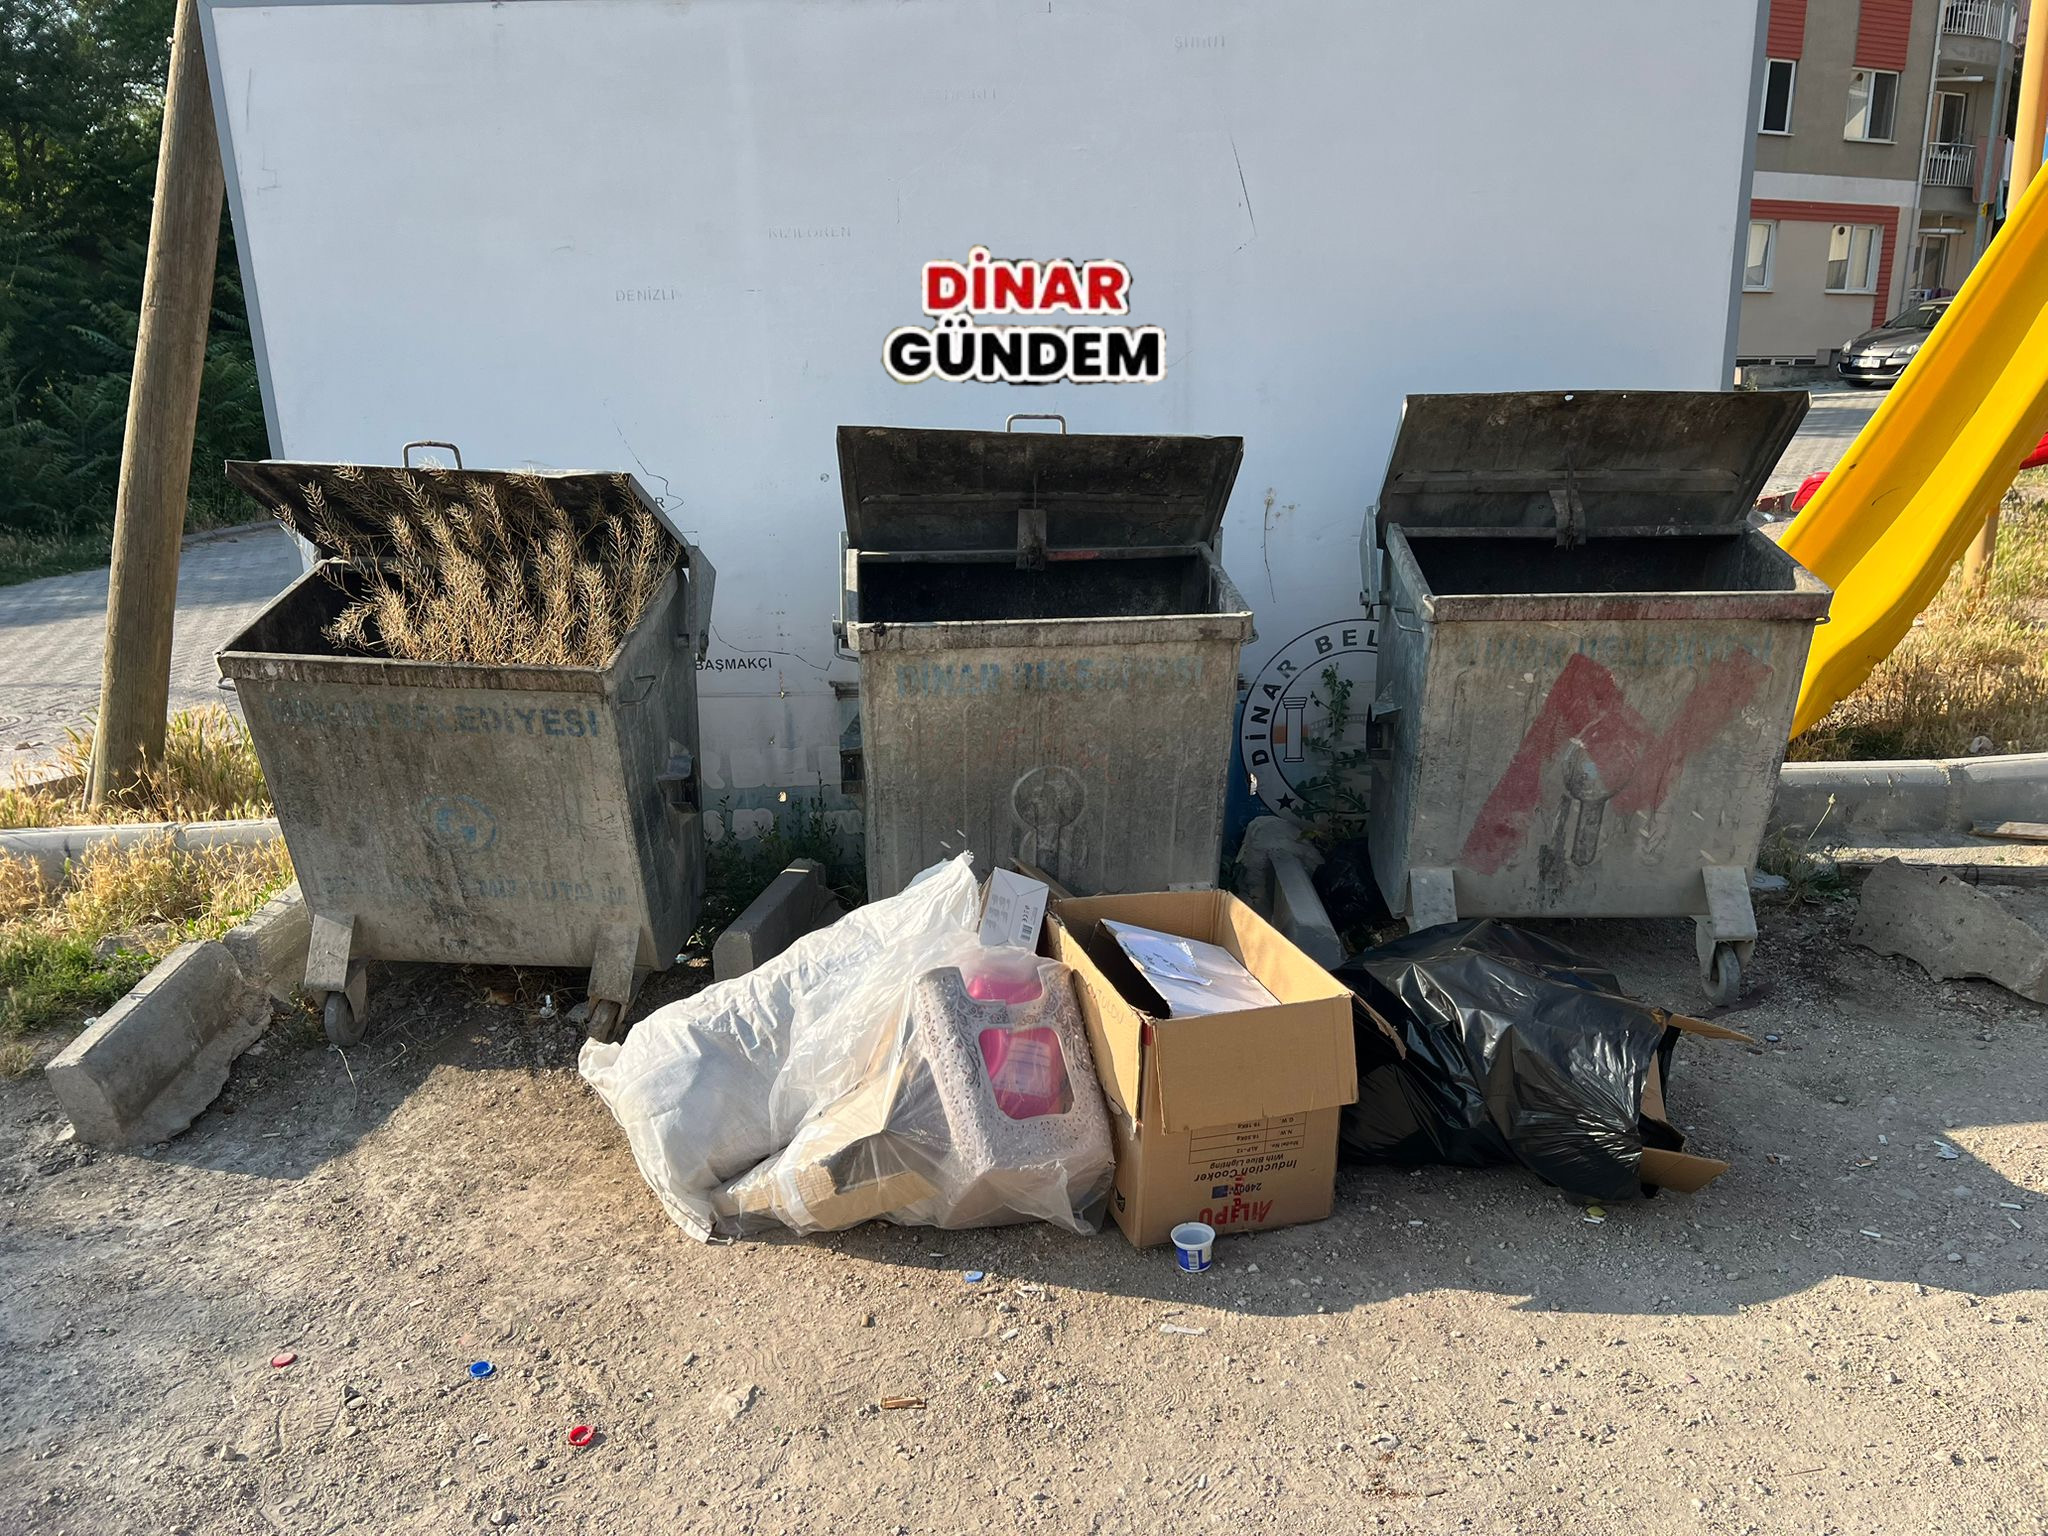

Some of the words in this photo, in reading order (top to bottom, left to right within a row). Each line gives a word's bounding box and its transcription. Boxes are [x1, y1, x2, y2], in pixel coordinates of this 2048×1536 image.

[1245, 659, 1298, 766] DİNAR
[1209, 1157, 1245, 1170] Lighting
[1246, 1156, 1264, 1165] Blue
[1265, 1153, 1284, 1162] With
[1241, 1159, 1297, 1177] Induction
[1194, 1169, 1238, 1182] Cooker
